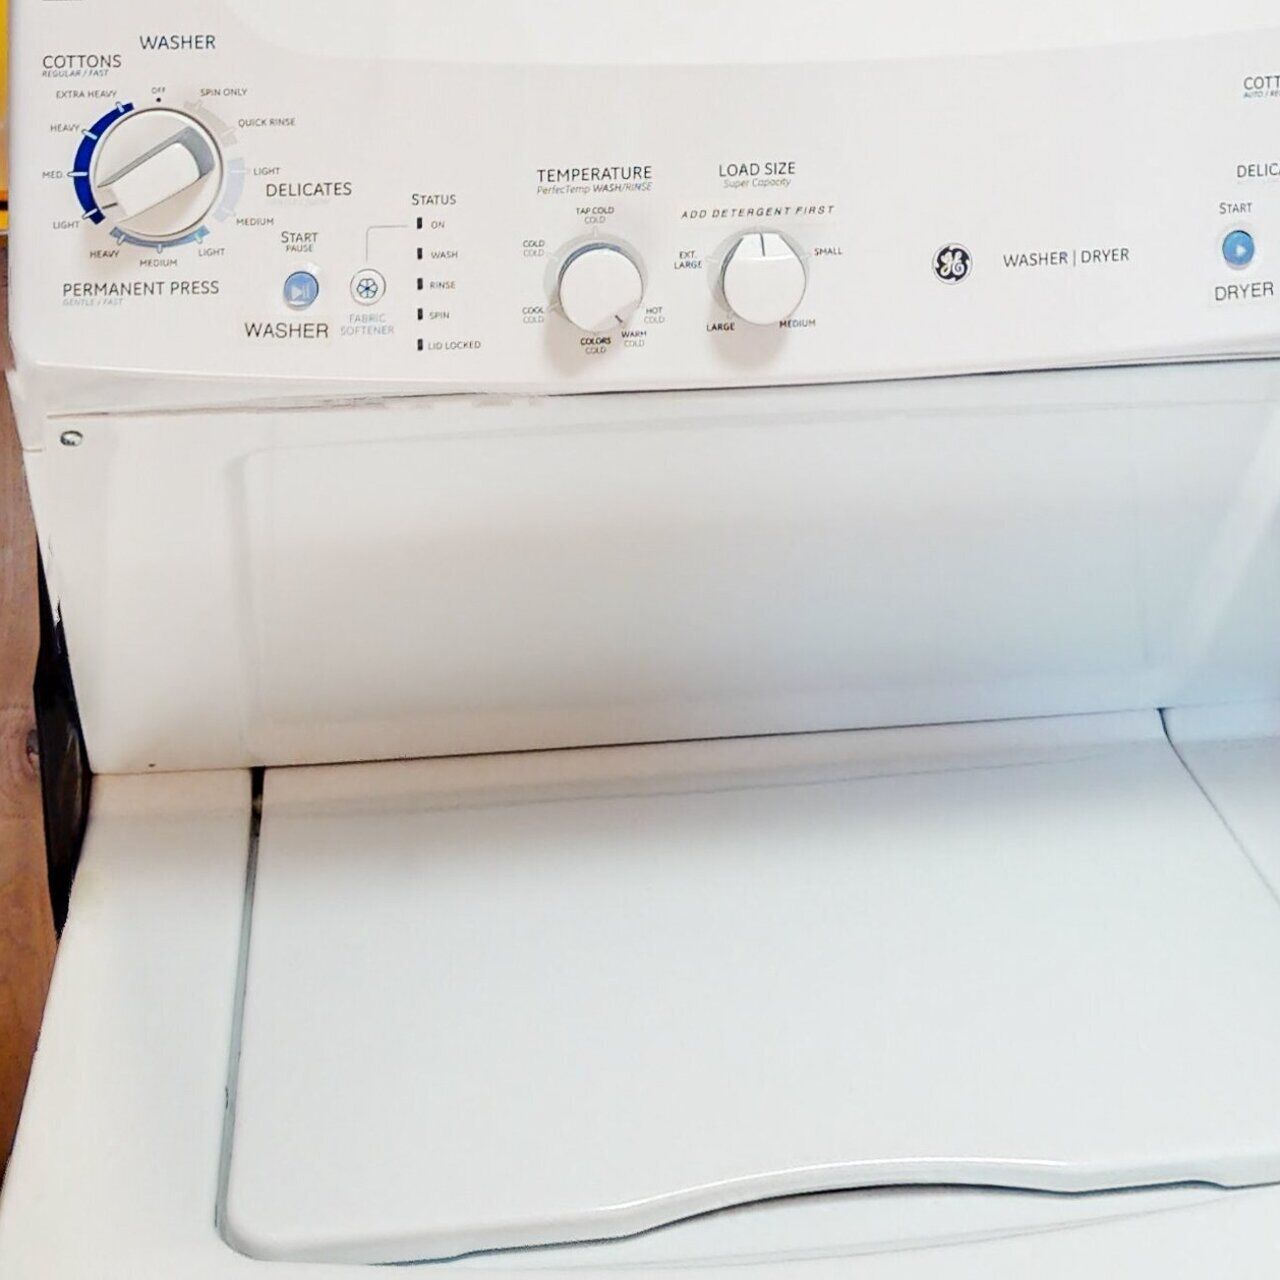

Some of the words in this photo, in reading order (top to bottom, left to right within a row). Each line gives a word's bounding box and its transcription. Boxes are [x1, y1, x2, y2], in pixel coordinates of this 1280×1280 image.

[139, 34, 217, 50] WASHER
[42, 54, 123, 69] COTTONS
[41, 70, 82, 78] REGULAR
[55, 89, 84, 99] EXTRA
[87, 89, 118, 99] HEAVY
[151, 86, 166, 95] OFF
[199, 88, 221, 97] SPIN
[222, 88, 248, 97] ONLY
[238, 118, 267, 128] QUICK
[268, 117, 296, 127] RINSE
[50, 124, 80, 133] HEAVY
[253, 167, 280, 176] LIGHT
[536, 165, 653, 183] TEMPERATURE
[718, 162, 761, 178] LOAD
[764, 161, 796, 176] SIZE
[536, 184, 590, 196] PerfecTemp
[592, 180, 653, 193] WASH/RINSE
[723, 179, 749, 190] Super
[751, 177, 792, 189] Capacity
[265, 182, 353, 198] DELICATES
[411, 193, 457, 207] STATUS
[575, 207, 591, 215] TAP
[592, 206, 615, 215] COLD
[680, 209, 708, 220] ADD
[711, 206, 792, 219] DETERGENT
[794, 204, 835, 216] FIRST
[1218, 201, 1253, 216] START
[52, 221, 80, 230] LIGHT
[235, 217, 275, 227] MEDIUM
[430, 220, 445, 230] ON
[583, 216, 606, 225] COLD
[280, 231, 319, 244] START
[285, 244, 314, 253] PAUSE
[522, 239, 546, 249] COLD
[89, 250, 120, 260] HEAVY
[198, 248, 226, 258] LIGHT
[430, 250, 459, 260] WASH
[522, 248, 545, 258] COLD
[814, 247, 843, 257] SMALL
[1002, 251, 1069, 268] WASHER
[1081, 247, 1130, 264] DRYER
[139, 259, 178, 268] MEDIUM
[673, 260, 703, 270] LARGE
[62, 282, 166, 298] PERMANENT
[170, 280, 220, 296] PRESS
[429, 280, 457, 290] RINSE
[1214, 281, 1275, 302] DRYER
[428, 310, 450, 320] SPIN
[645, 306, 662, 315] HOT
[348, 313, 387, 323] FABRIC
[522, 315, 545, 324] COLD
[643, 315, 666, 324] COLD
[706, 322, 736, 332] LARGE
[779, 319, 816, 329] MEDIUM
[244, 322, 330, 340] WASHER
[340, 325, 394, 336] SOFTENER
[620, 330, 647, 339] WARM
[427, 340, 443, 351] LID
[444, 340, 482, 351] LOCKED
[580, 337, 612, 346] COLORS
[623, 339, 645, 348] COLD
[585, 346, 606, 355] COLD
